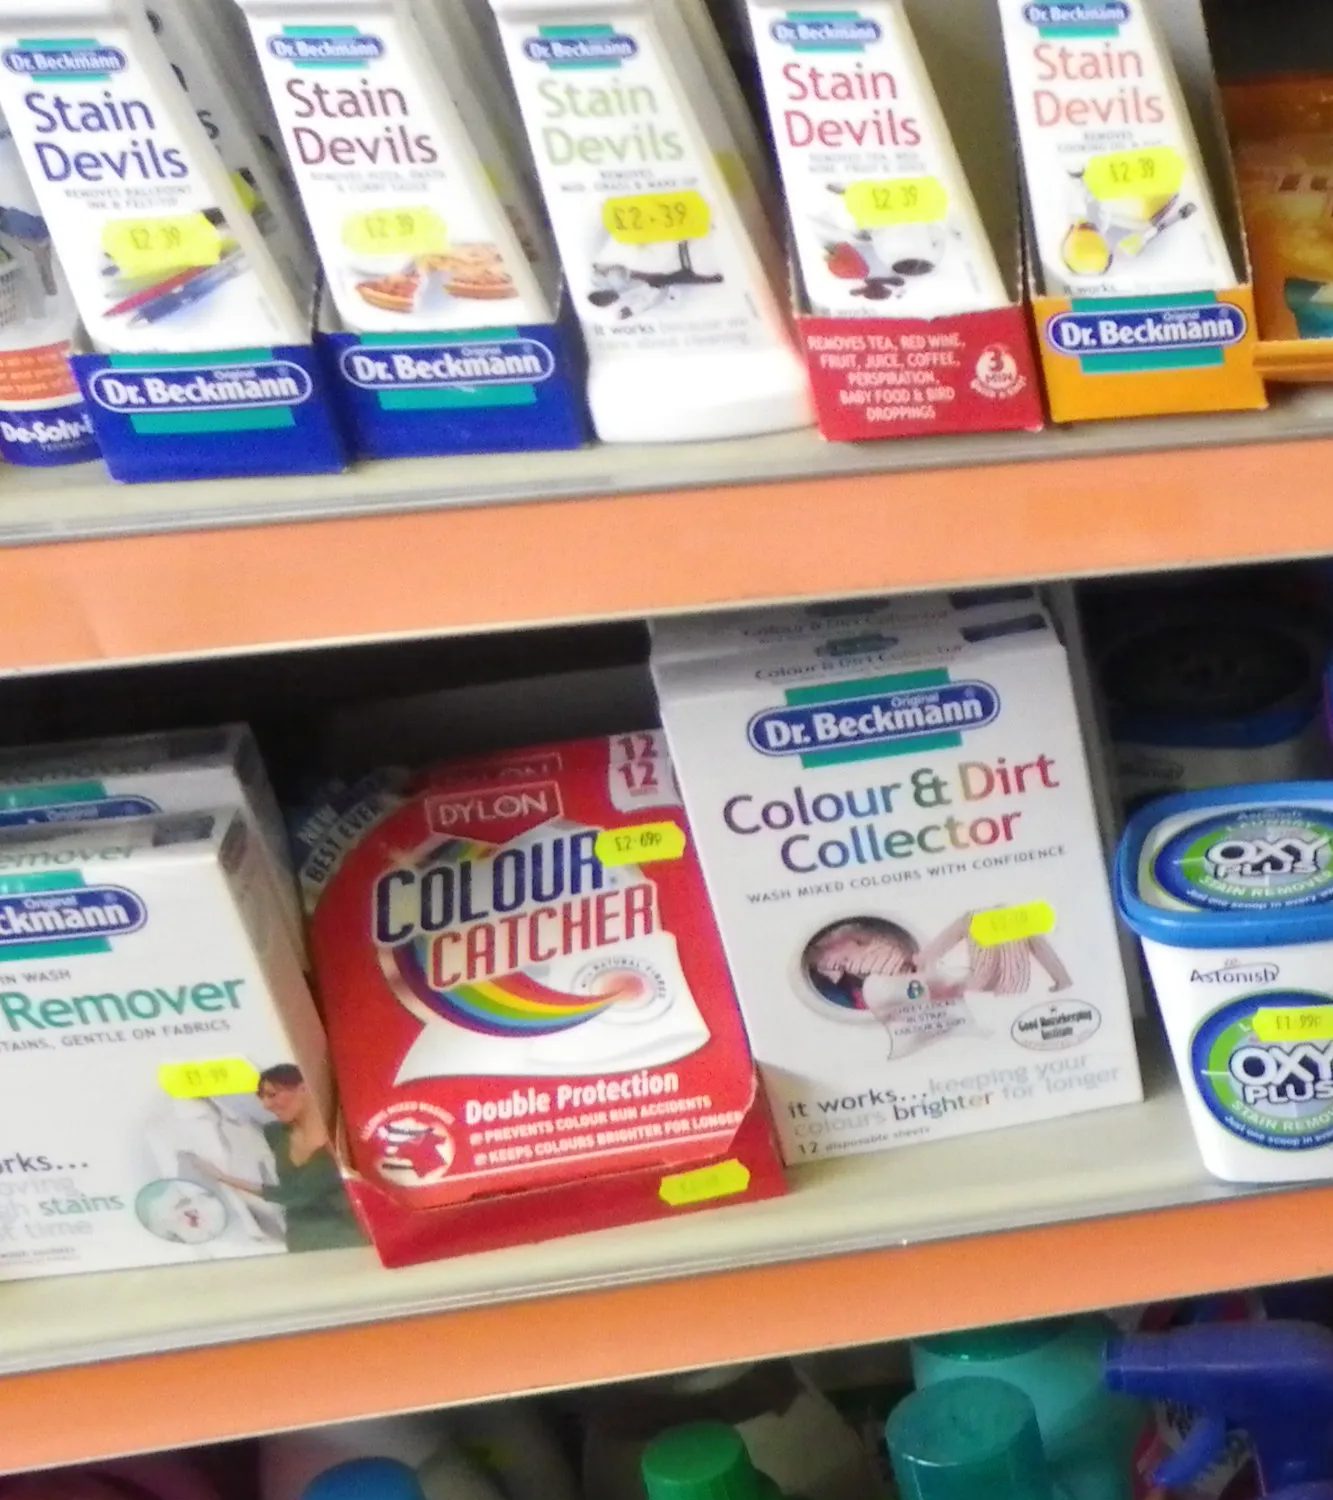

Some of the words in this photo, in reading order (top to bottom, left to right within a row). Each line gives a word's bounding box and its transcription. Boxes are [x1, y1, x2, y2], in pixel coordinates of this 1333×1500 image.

[801, 21, 879, 44] Beckmann
[1050, 3, 1127, 24] Beckmann
[41, 48, 121, 72] Beckmann
[303, 37, 383, 60] Beckmann
[554, 36, 633, 58] Beckmann
[1034, 43, 1143, 83] Stain
[287, 78, 409, 119] Stain
[539, 78, 658, 120] Stain
[783, 62, 898, 102] Stain
[25, 91, 155, 133] Stain
[784, 108, 921, 149] Devils
[1034, 89, 1165, 129] Devils
[34, 138, 189, 182] Devils
[293, 125, 438, 165] Devils
[544, 124, 684, 168] Devils
[1059, 321, 1097, 346] Dr.
[1100, 313, 1235, 343] Beckmann
[352, 356, 393, 383] Dr.
[394, 346, 541, 379] Beckmann
[103, 378, 144, 406] Dr.
[146, 371, 300, 404] Beckmann
[866, 405, 936, 422] DROPPINGS
[766, 720, 813, 748] Dr.
[816, 697, 982, 740] Beckmann
[617, 733, 659, 760] 12
[618, 762, 660, 791] 12
[723, 784, 901, 836] Colour
[913, 769, 952, 810] &
[959, 754, 1060, 798] Dirt
[439, 790, 548, 826] DYLON
[781, 808, 1022, 876] Collector
[1206, 833, 1332, 866] OXY
[376, 829, 605, 944] COLOUR
[746, 887, 791, 904] WASH
[798, 882, 844, 898] MIXED
[850, 870, 921, 889] COLOURS
[927, 863, 967, 878] WITH
[973, 845, 1066, 870] CONFIDENCE
[1215, 861, 1320, 880] PLUS
[431, 883, 656, 989] CATCHER
[22, 969, 71, 982] WASH
[1190, 963, 1281, 985] Astonish
[7, 977, 247, 1033] Remover
[62, 1031, 125, 1048] GENTLE
[162, 1019, 232, 1037] FABRICS
[465, 1087, 551, 1126] Double
[556, 1070, 680, 1110] Protection
[892, 1090, 995, 1124] brighter
[484, 1119, 553, 1144] PREVENTS
[555, 1111, 608, 1133] COLOUR
[640, 1095, 713, 1120] ACCIDENTS
[487, 1145, 533, 1165] KEEPS
[535, 1135, 595, 1160] COLOURS
[597, 1124, 662, 1147] BRIGHTER
[693, 1110, 743, 1132] LONGER
[38, 1192, 126, 1218] stains
